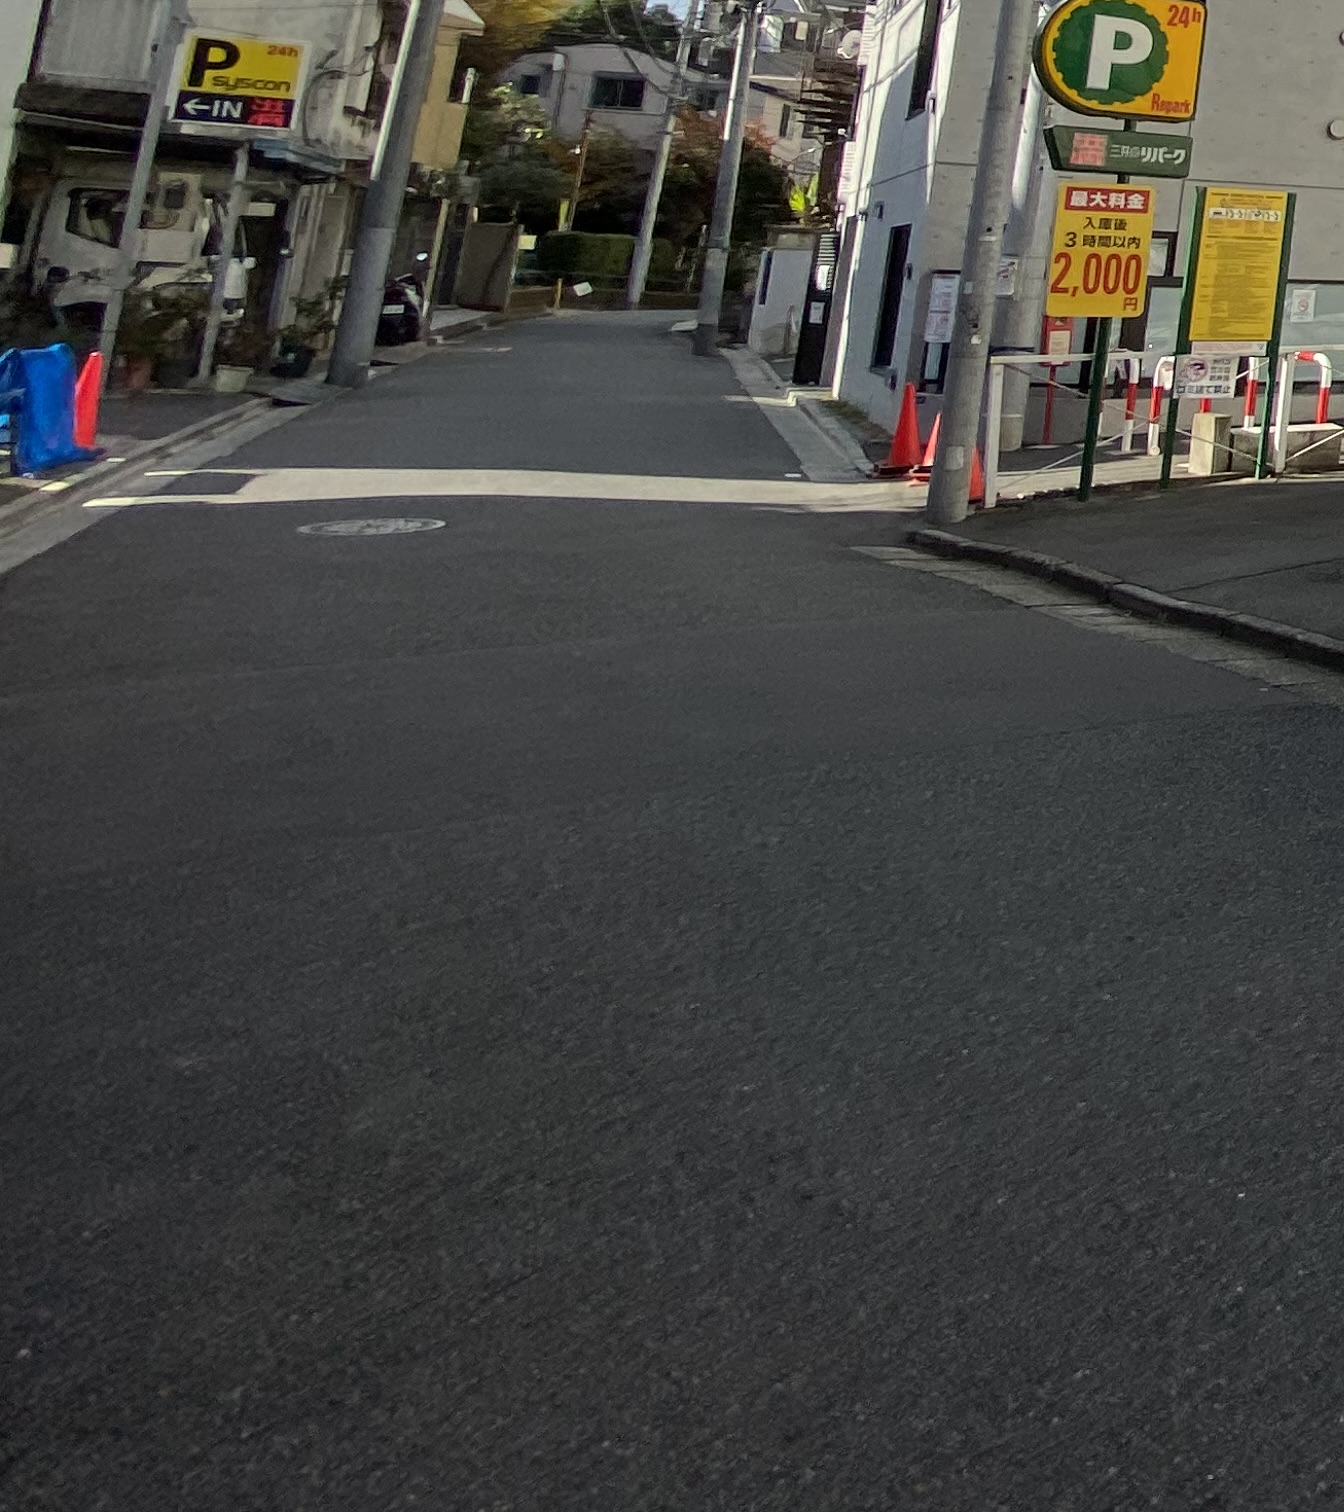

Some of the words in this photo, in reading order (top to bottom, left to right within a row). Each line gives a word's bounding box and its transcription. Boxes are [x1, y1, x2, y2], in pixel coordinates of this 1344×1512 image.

[1167, 4, 1201, 28] 24h
[188, 38, 240, 87] P
[1086, 14, 1153, 90] P
[211, 100, 243, 118] IN
[1151, 92, 1191, 114] Repark
[1070, 190, 1145, 210] 最大料金
[1082, 217, 1127, 231] 入庫後
[1050, 252, 1142, 297] 2,000
[1123, 296, 1138, 311] 円
